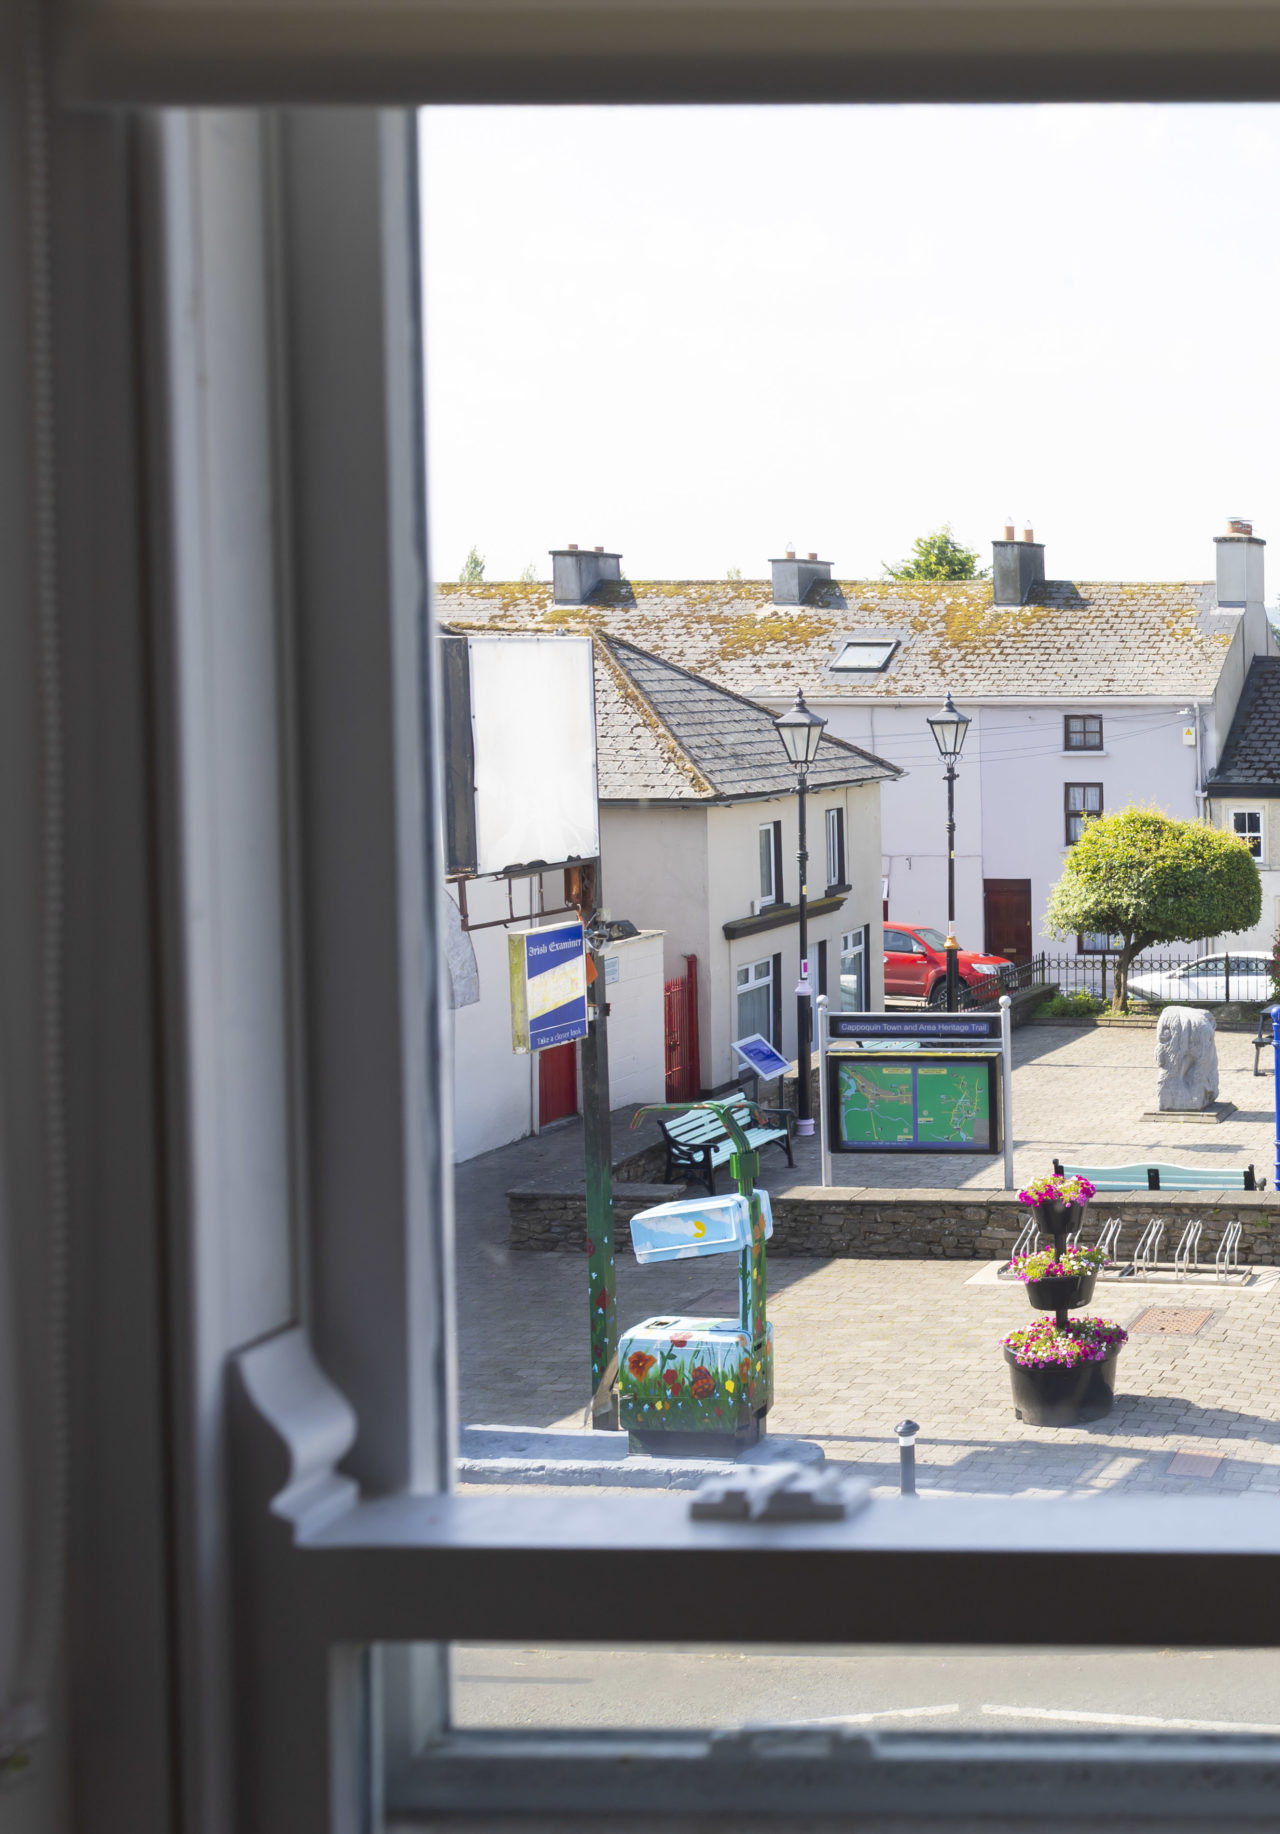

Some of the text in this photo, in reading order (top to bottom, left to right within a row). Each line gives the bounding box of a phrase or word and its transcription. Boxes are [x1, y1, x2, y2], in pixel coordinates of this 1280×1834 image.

[528, 938, 582, 957] Irish Examiner
[537, 1037, 549, 1045] Take
[554, 1032, 570, 1041] closer
[570, 1027, 582, 1036] look
[841, 1023, 987, 1033] Cappoquin Town and Area Heritage Trail
